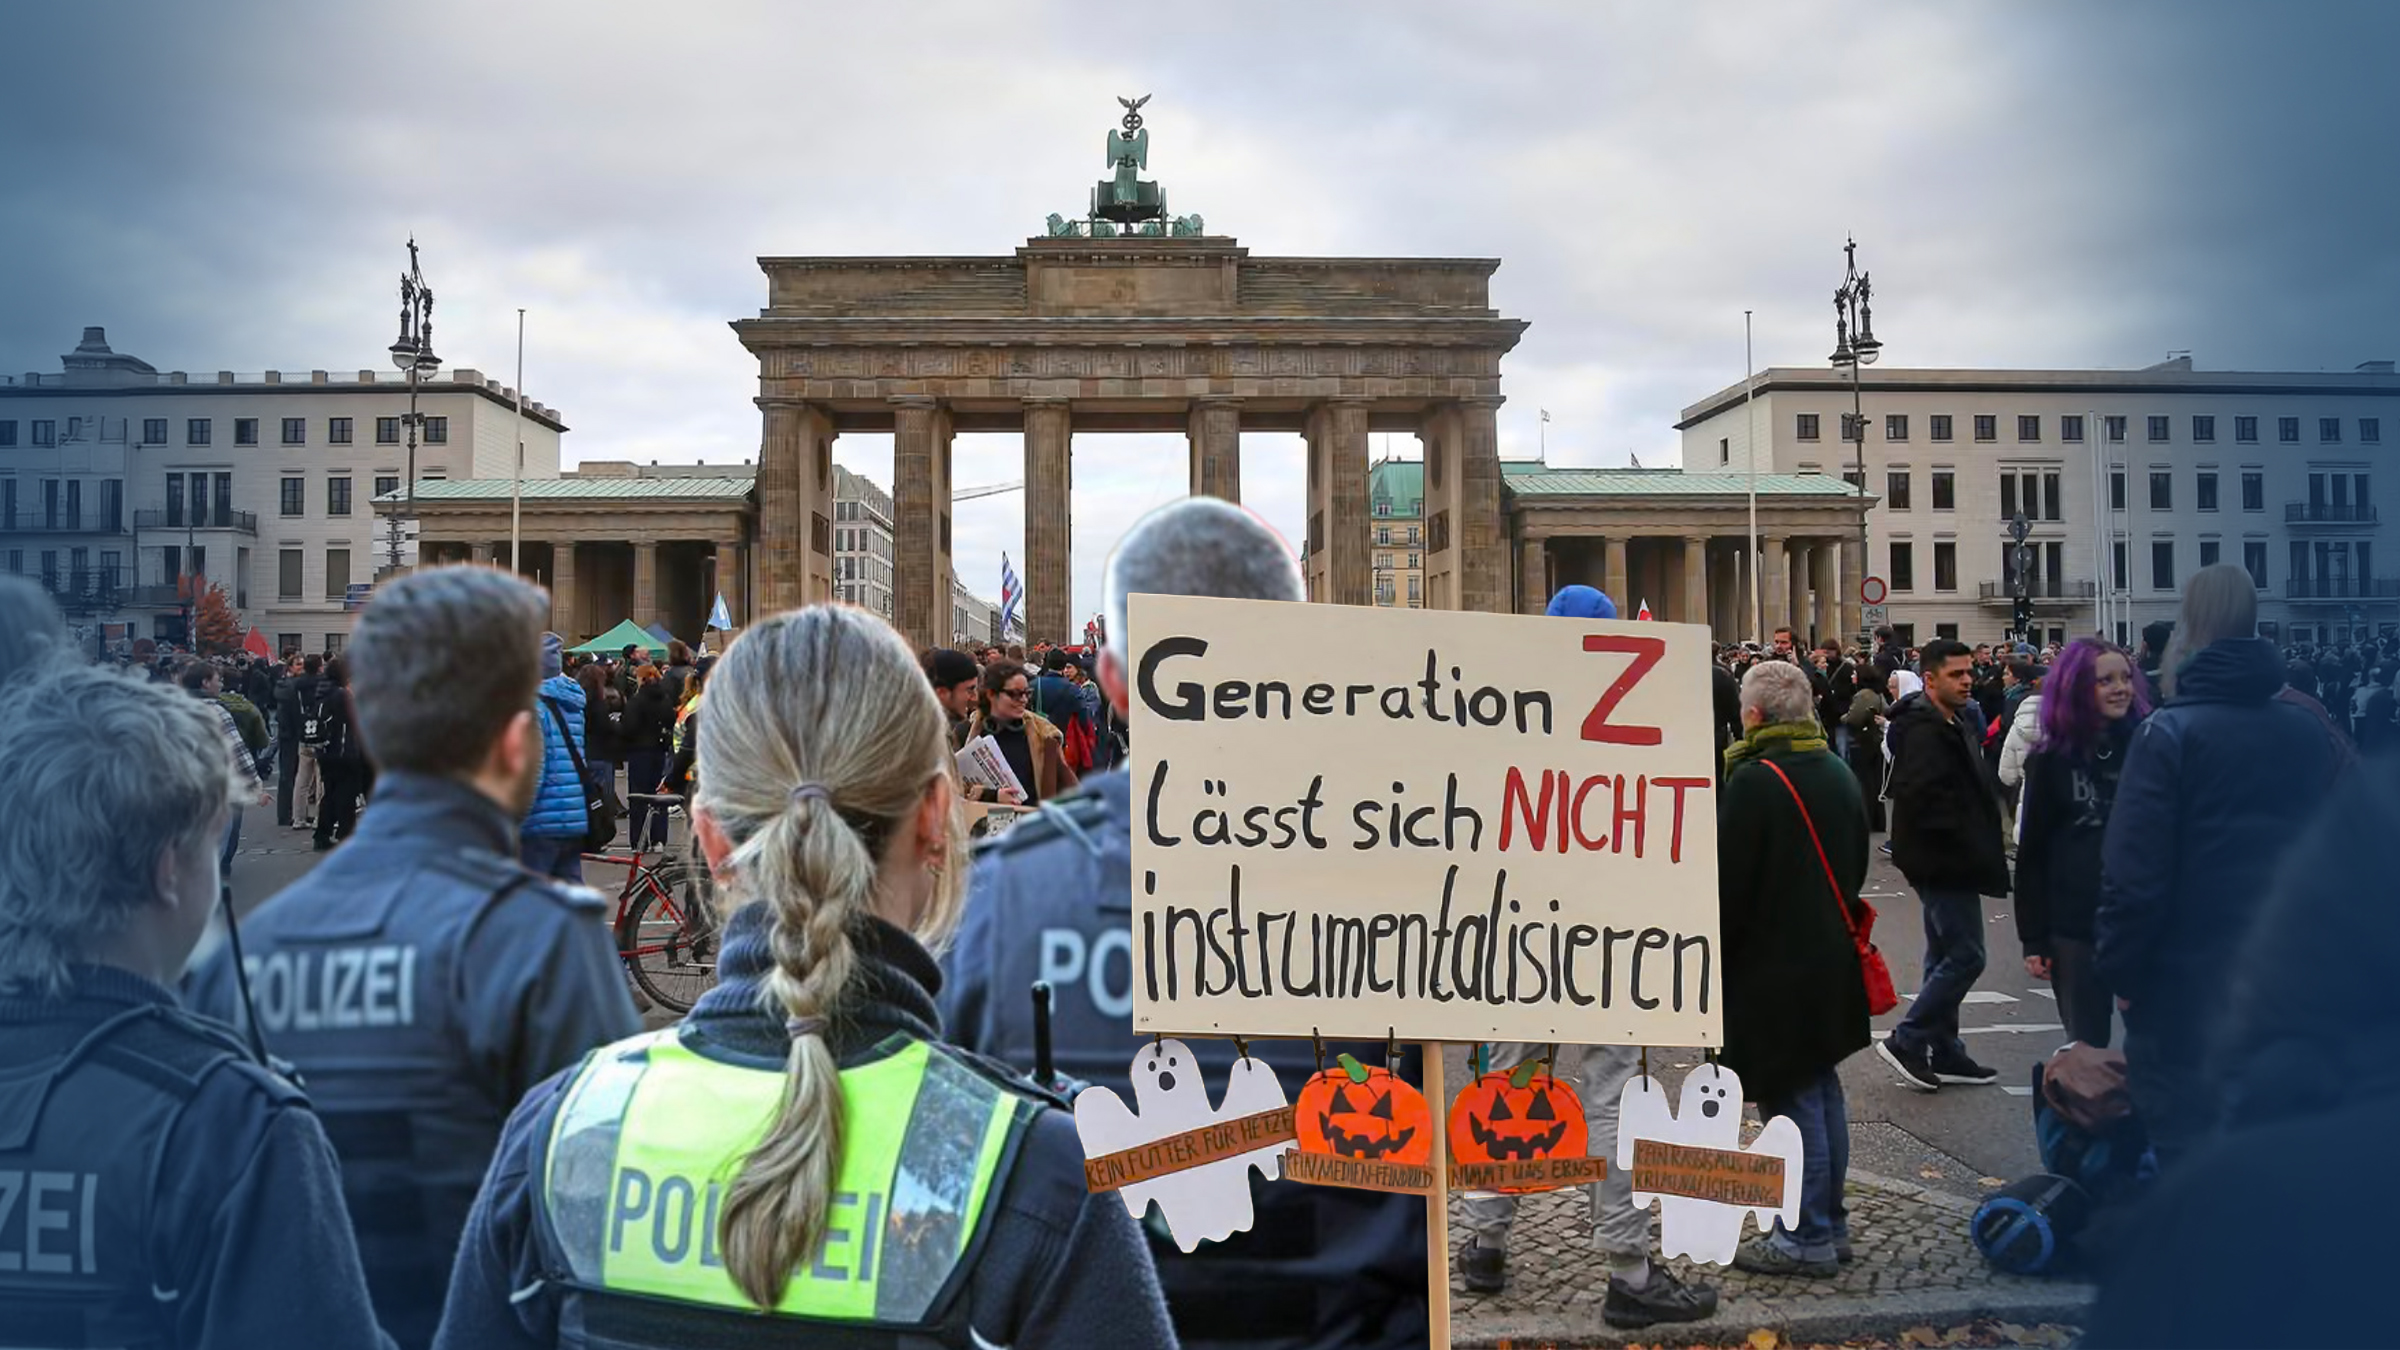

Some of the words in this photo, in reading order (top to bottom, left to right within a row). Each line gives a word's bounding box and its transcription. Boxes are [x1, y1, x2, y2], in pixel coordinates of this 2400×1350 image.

[1136, 635, 1553, 734] Generation
[1580, 634, 1667, 746] Z
[1351, 772, 1484, 852] sich
[1498, 766, 1711, 864] NICHT
[1142, 864, 1712, 1014] instrumentalisieren
[1085, 1156, 1126, 1189] KEIN
[1127, 1135, 1200, 1175] FUTTER
[1203, 1121, 1238, 1155] FÜR
[1286, 1150, 1317, 1178] KEIN
[1450, 1163, 1507, 1187] NIMMT
[1552, 1158, 1605, 1179] ERNST
[609, 1167, 883, 1282] POLEI
